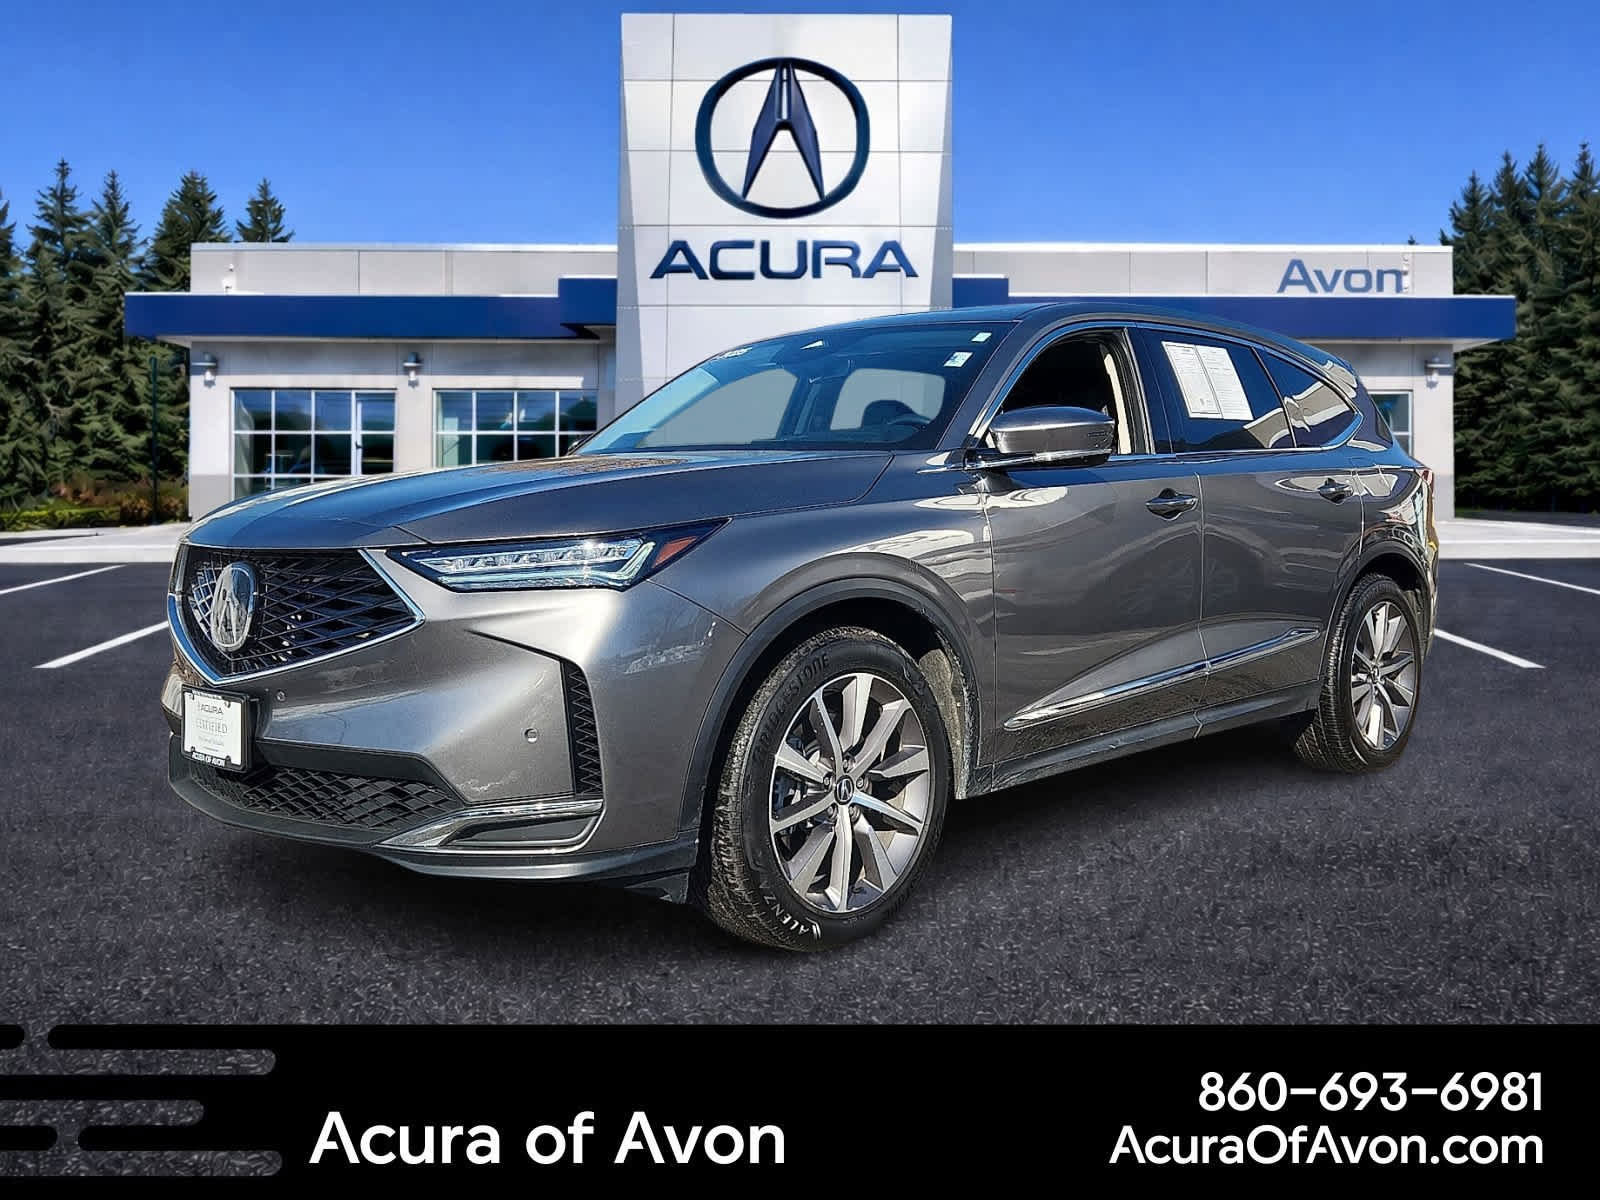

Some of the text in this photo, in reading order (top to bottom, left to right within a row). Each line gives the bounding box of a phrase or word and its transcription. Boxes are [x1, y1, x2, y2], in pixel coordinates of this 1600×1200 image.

[650, 241, 918, 281] ACURA
[1277, 259, 1403, 293] Avon
[200, 703, 223, 715] ACURA
